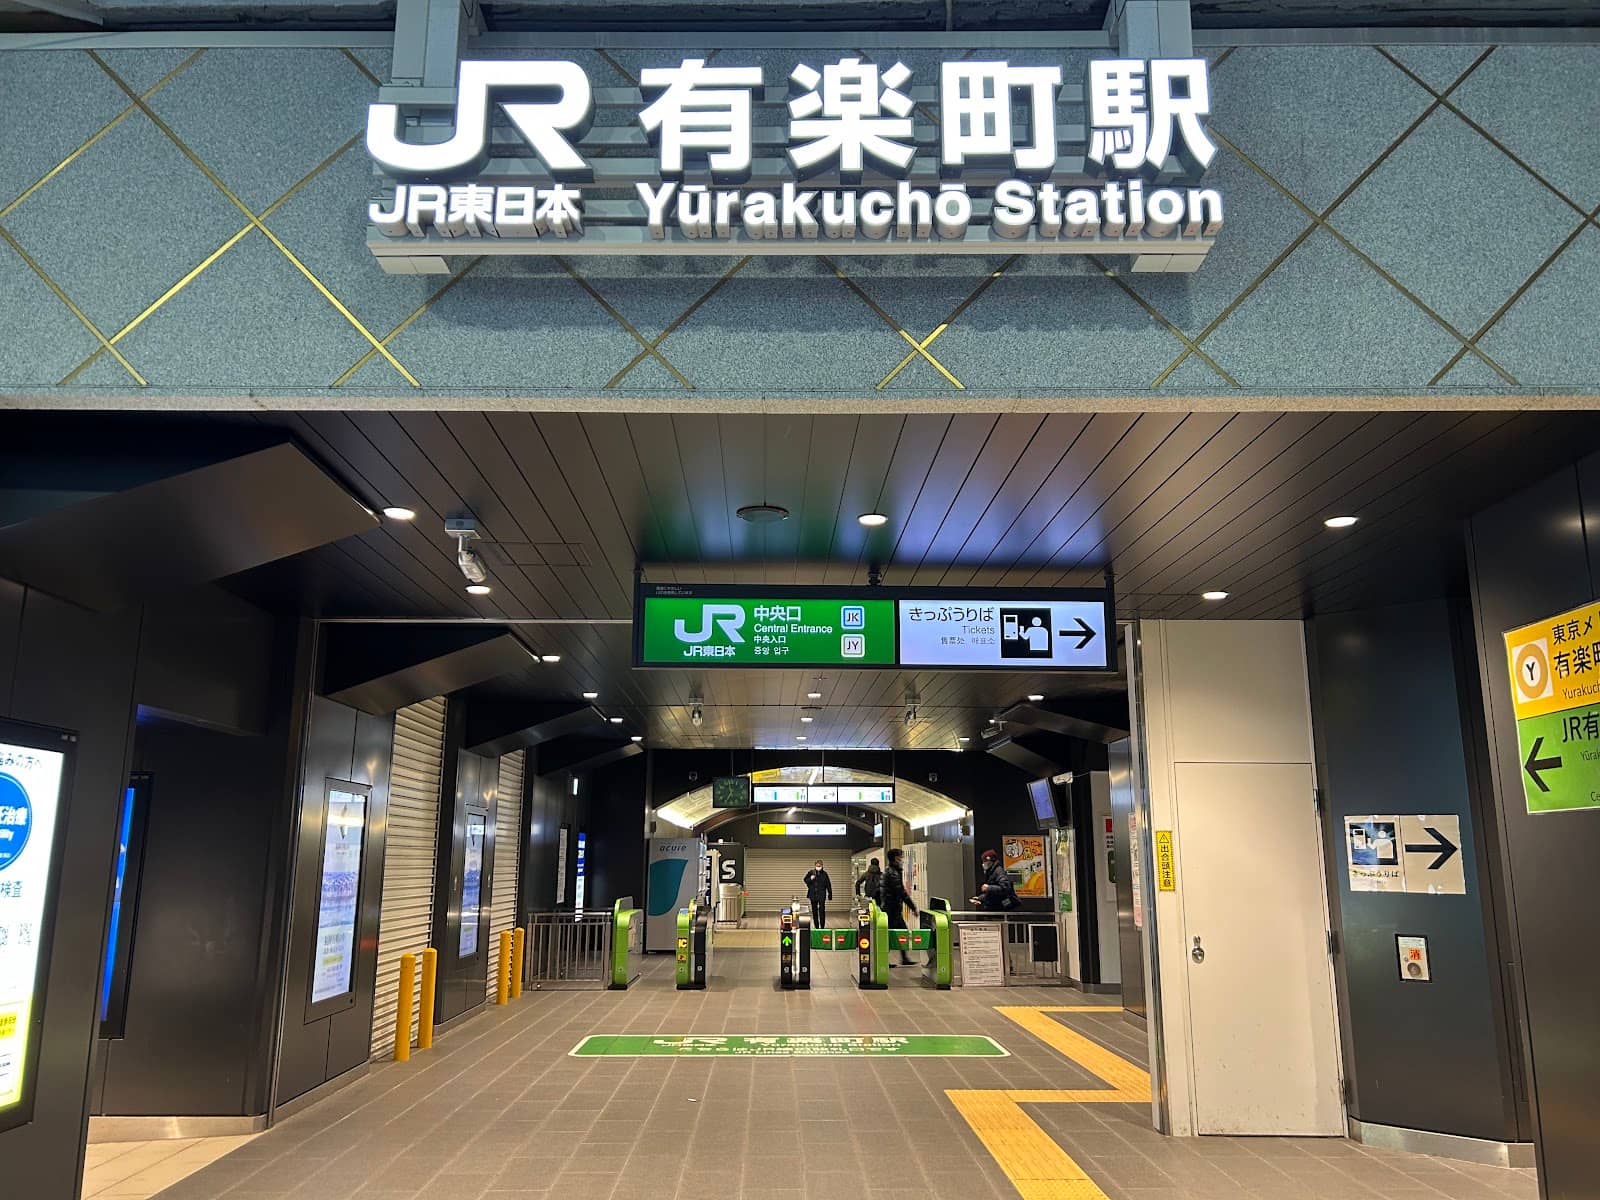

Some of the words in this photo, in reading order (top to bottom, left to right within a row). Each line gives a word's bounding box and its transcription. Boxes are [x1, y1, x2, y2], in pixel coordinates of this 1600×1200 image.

[366, 60, 591, 170] JR
[638, 57, 1217, 170] 有楽町駅
[368, 184, 582, 224] JR東日本
[635, 180, 973, 226] Yūrakuchō
[993, 179, 1222, 226] Station
[753, 605, 801, 622] 中央口
[847, 612, 859, 622] JK
[909, 606, 995, 622] きっぷうりば
[674, 604, 746, 643] JR
[753, 623, 788, 633] Central
[791, 623, 833, 634] Entrance
[962, 625, 995, 634] Tickets
[1552, 611, 1600, 645] 東京メ
[753, 635, 786, 644] 中央入口
[847, 641, 859, 650] JY
[683, 645, 736, 657] JR東日本
[1525, 662, 1536, 681] Y
[1562, 711, 1600, 743] JR有
[659, 843, 687, 852] acure
